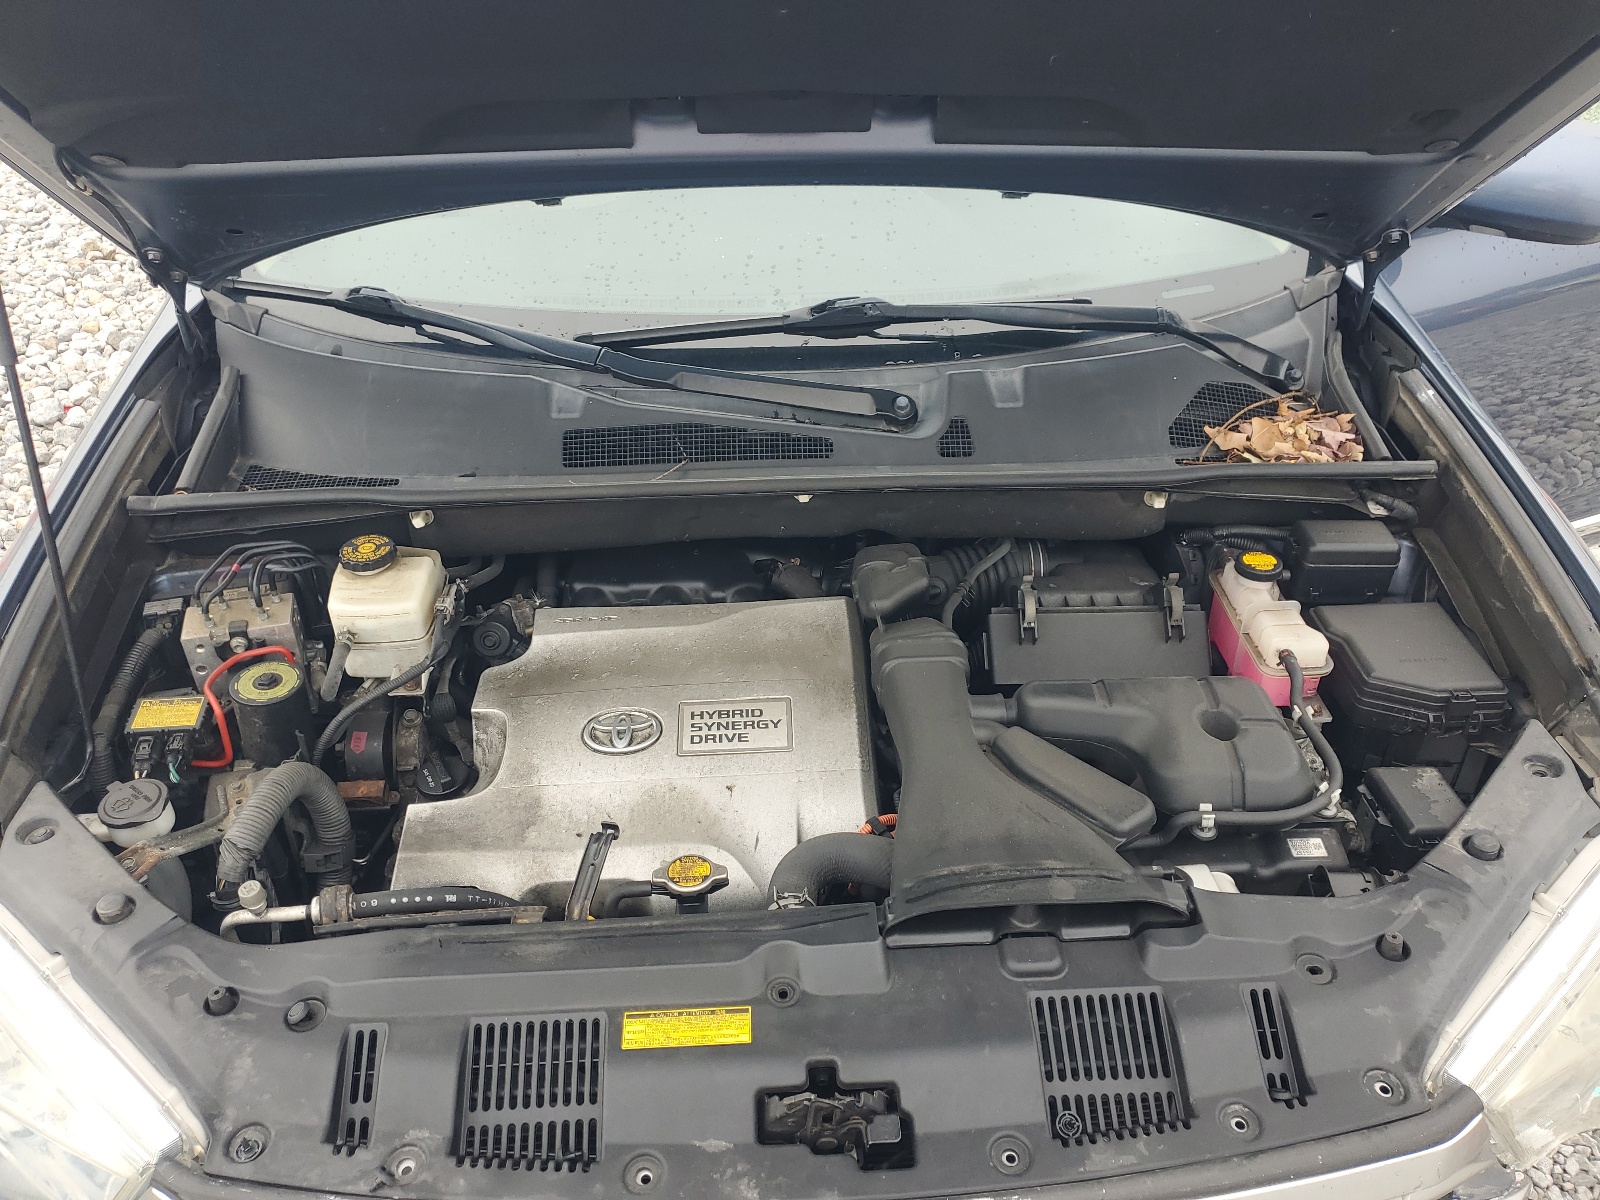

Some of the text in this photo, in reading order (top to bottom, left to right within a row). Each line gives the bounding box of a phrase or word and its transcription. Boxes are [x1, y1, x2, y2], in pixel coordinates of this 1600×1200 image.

[690, 708, 764, 720] HYBRID
[690, 718, 783, 732] SYNERGY
[690, 732, 750, 744] DRIVE
